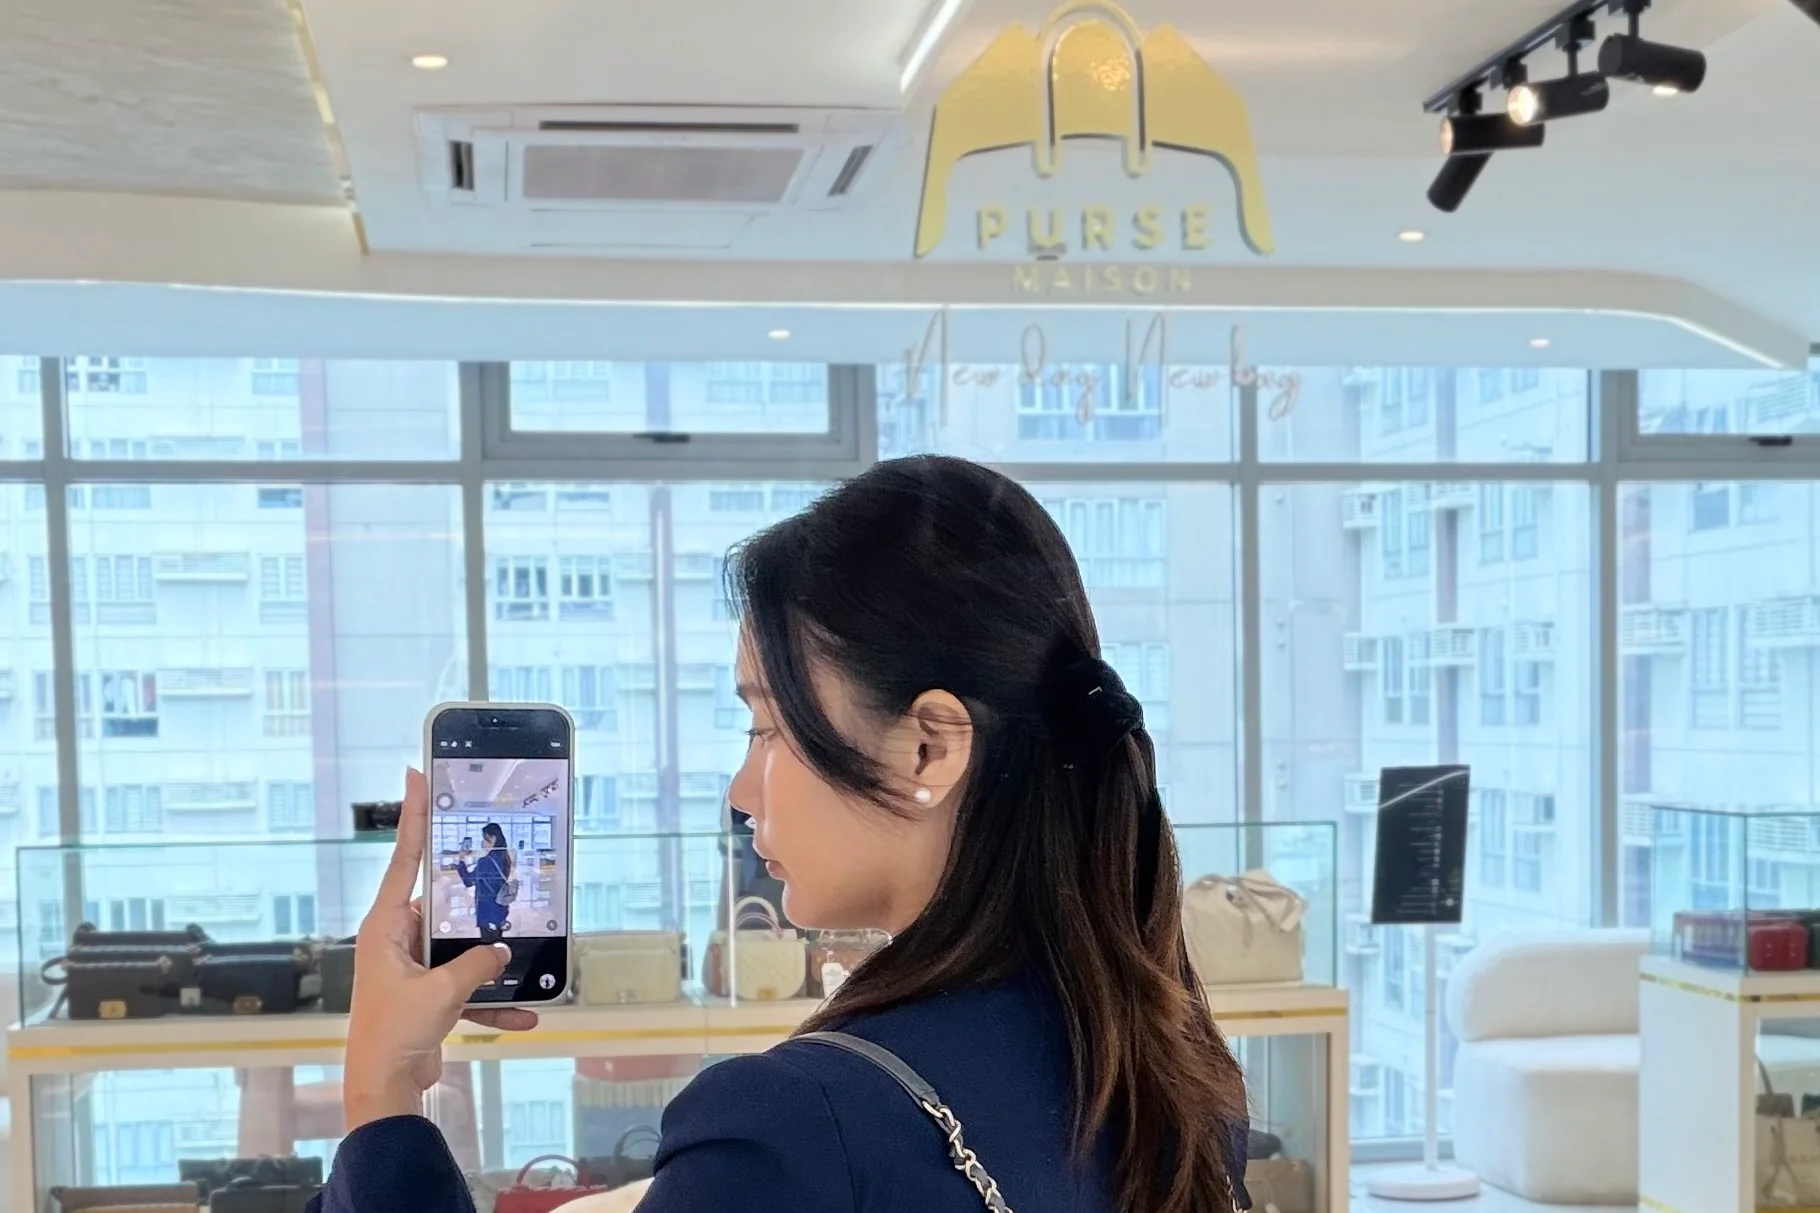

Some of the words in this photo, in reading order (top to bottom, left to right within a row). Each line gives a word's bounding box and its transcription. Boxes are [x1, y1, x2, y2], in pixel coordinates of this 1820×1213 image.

[977, 203, 1213, 251] PURSE
[1013, 265, 1193, 292] MAISON
[905, 306, 1000, 430] New
[1124, 311, 1225, 432] New
